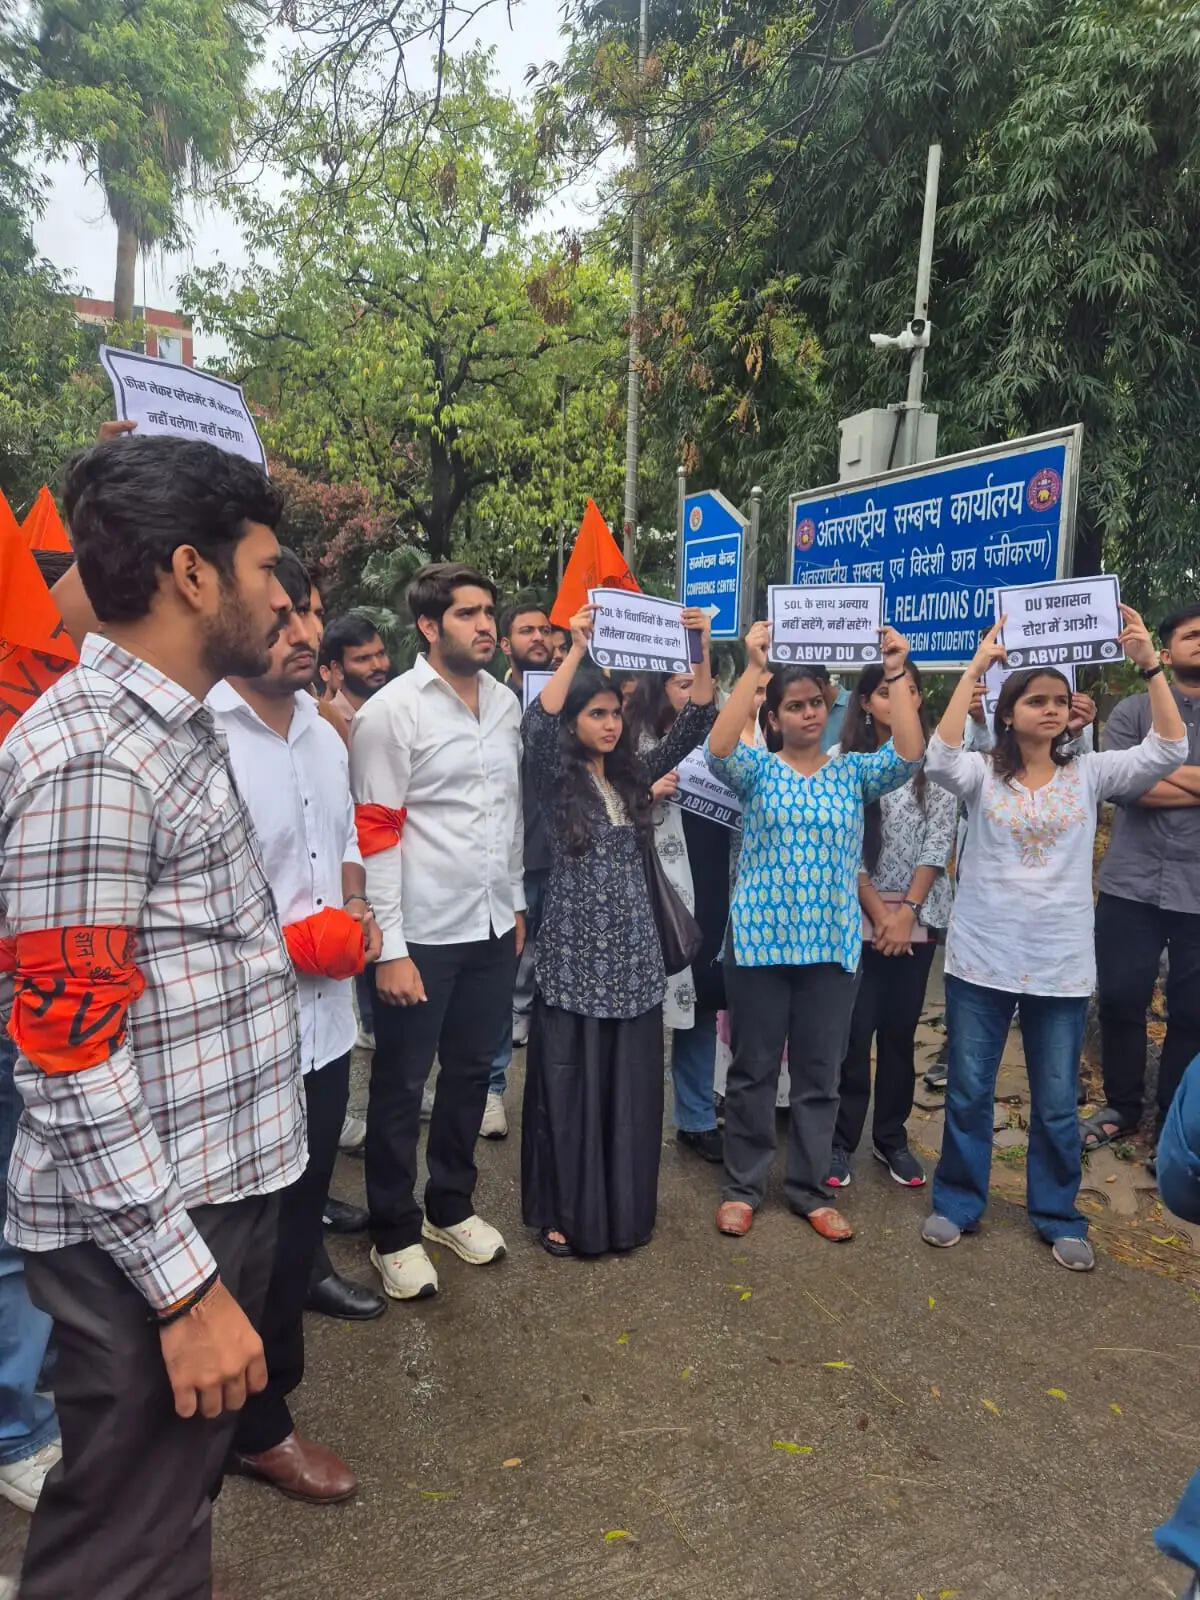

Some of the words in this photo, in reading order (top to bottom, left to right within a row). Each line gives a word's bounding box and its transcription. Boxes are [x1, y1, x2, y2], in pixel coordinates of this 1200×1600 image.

[122, 375, 147, 391] फीस
[147, 381, 172, 398] लेकर
[172, 387, 207, 408] प्लेसमेंट
[146, 410, 168, 426] नहीं
[168, 414, 199, 433] चलेगा!
[198, 422, 217, 437] नहीं
[217, 425, 244, 443] चलेगा!
[816, 498, 886, 548] अंतरराष्ट्रीय
[893, 496, 942, 534] सम्बन्ध
[950, 472, 1025, 525] कार्यालय
[688, 551, 717, 571] सम्मेलन
[718, 548, 737, 567] केन्द्र
[852, 561, 884, 583] सम्बन्ध
[889, 549, 905, 583] एवं
[909, 542, 944, 578] विदेशी
[951, 547, 977, 571] छात्र
[983, 529, 1053, 571] पंजीकरण)
[686, 580, 716, 596] CONFERENCE
[716, 578, 736, 594] CENTRE
[784, 600, 802, 610] SOL
[804, 598, 814, 609] के
[815, 599, 836, 609] साथ
[838, 599, 869, 610] अन्याय
[895, 589, 969, 623] RELATIONS
[1025, 598, 1043, 612] DU
[1045, 592, 1092, 609] प्रशासन
[599, 607, 614, 618] SOL
[615, 608, 623, 620] के
[656, 614, 664, 627] के
[664, 618, 680, 629] साथ
[781, 616, 802, 630] नहीं
[801, 616, 825, 631] सहेंगे,
[826, 616, 847, 630] नहीं
[847, 617, 872, 630] सहेंगे!
[1022, 620, 1046, 637] होश
[1048, 617, 1062, 634] में
[1063, 614, 1098, 632] आओ!
[599, 625, 625, 641] सौतेला
[626, 631, 652, 644] व्यवहार
[652, 634, 664, 647] बंद
[664, 636, 681, 649] करो!
[930, 630, 975, 651] STUDENTS
[614, 654, 647, 669] ABVP
[650, 657, 668, 671] DU
[795, 646, 832, 661] ABVP
[836, 646, 855, 661] DU
[1028, 646, 1068, 665] ABVP
[1072, 645, 1093, 661] DU
[683, 795, 714, 814] ABVP
[714, 807, 732, 822] DU
